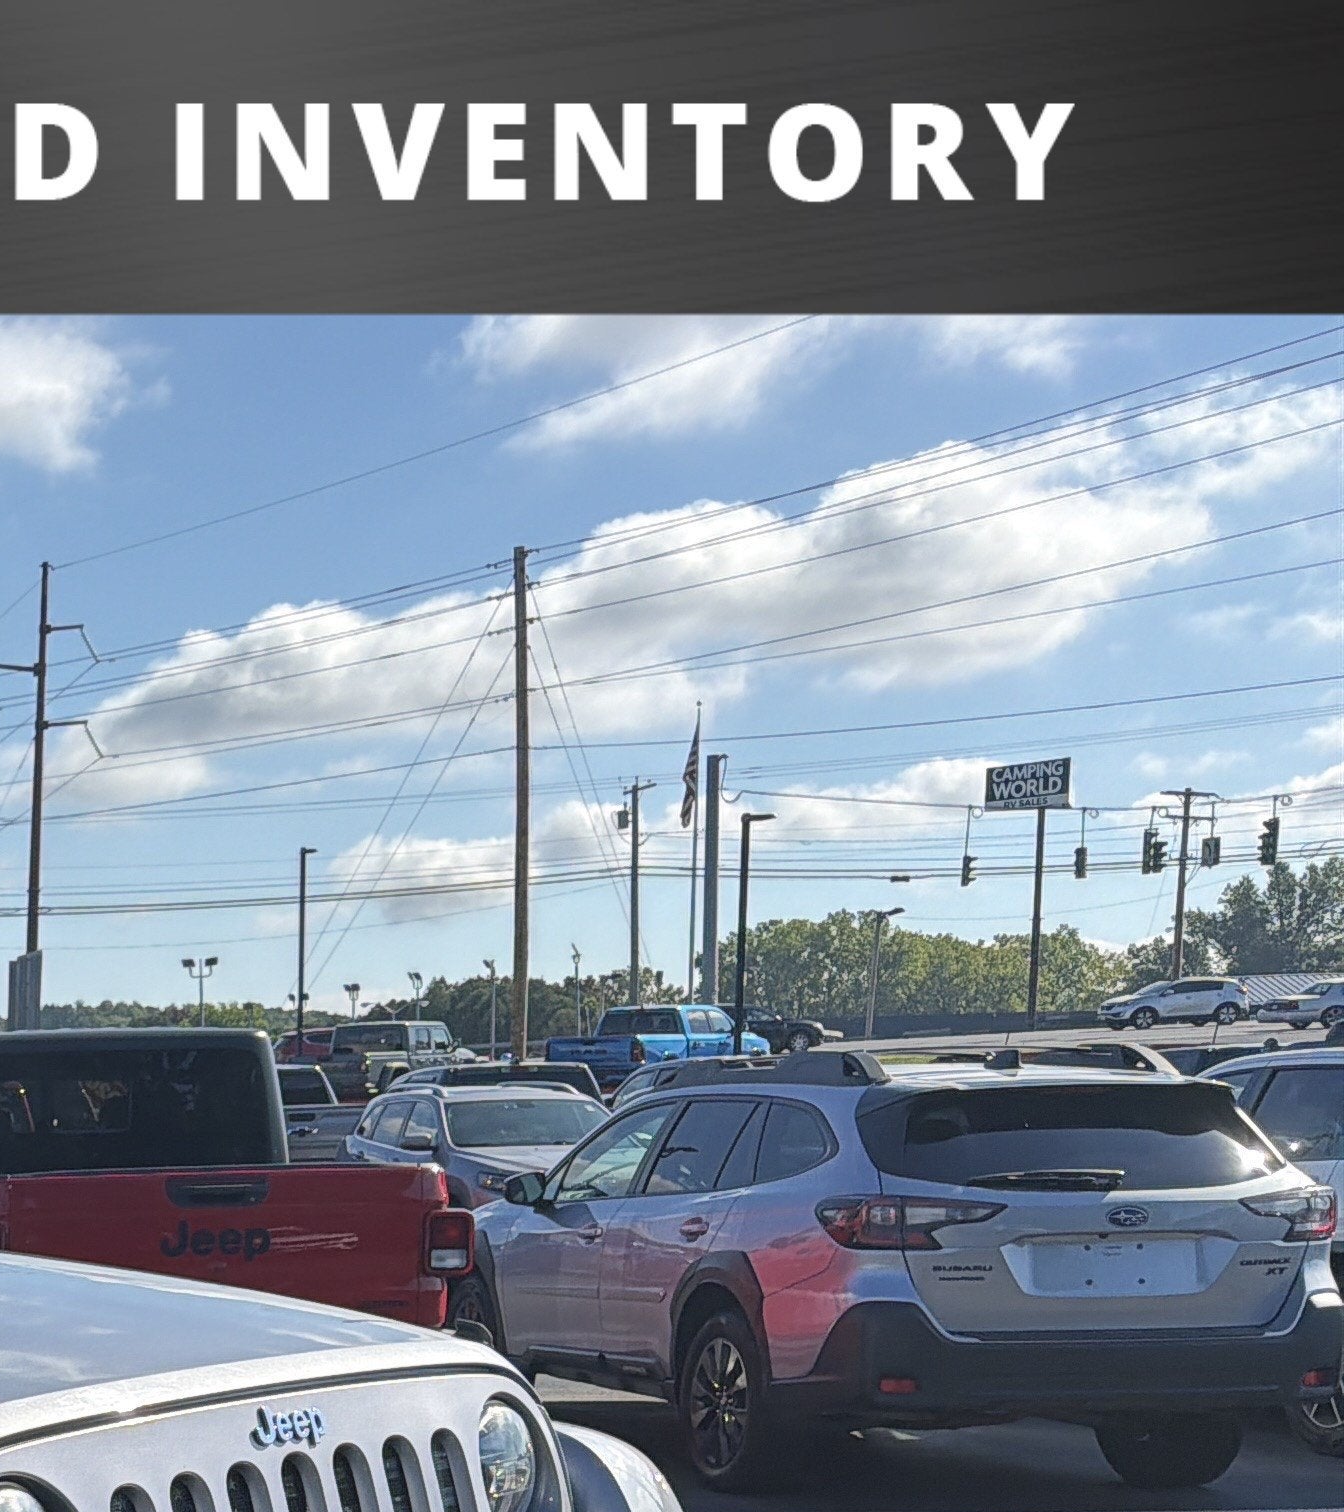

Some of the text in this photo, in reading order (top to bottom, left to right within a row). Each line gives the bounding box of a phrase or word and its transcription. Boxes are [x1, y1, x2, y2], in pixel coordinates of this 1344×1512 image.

[992, 761, 1064, 782] CAMPING
[993, 776, 1062, 800] WORLD
[1019, 797, 1048, 807] SALES
[160, 1220, 271, 1261] Jeep
[255, 1404, 325, 1444] Jeep
